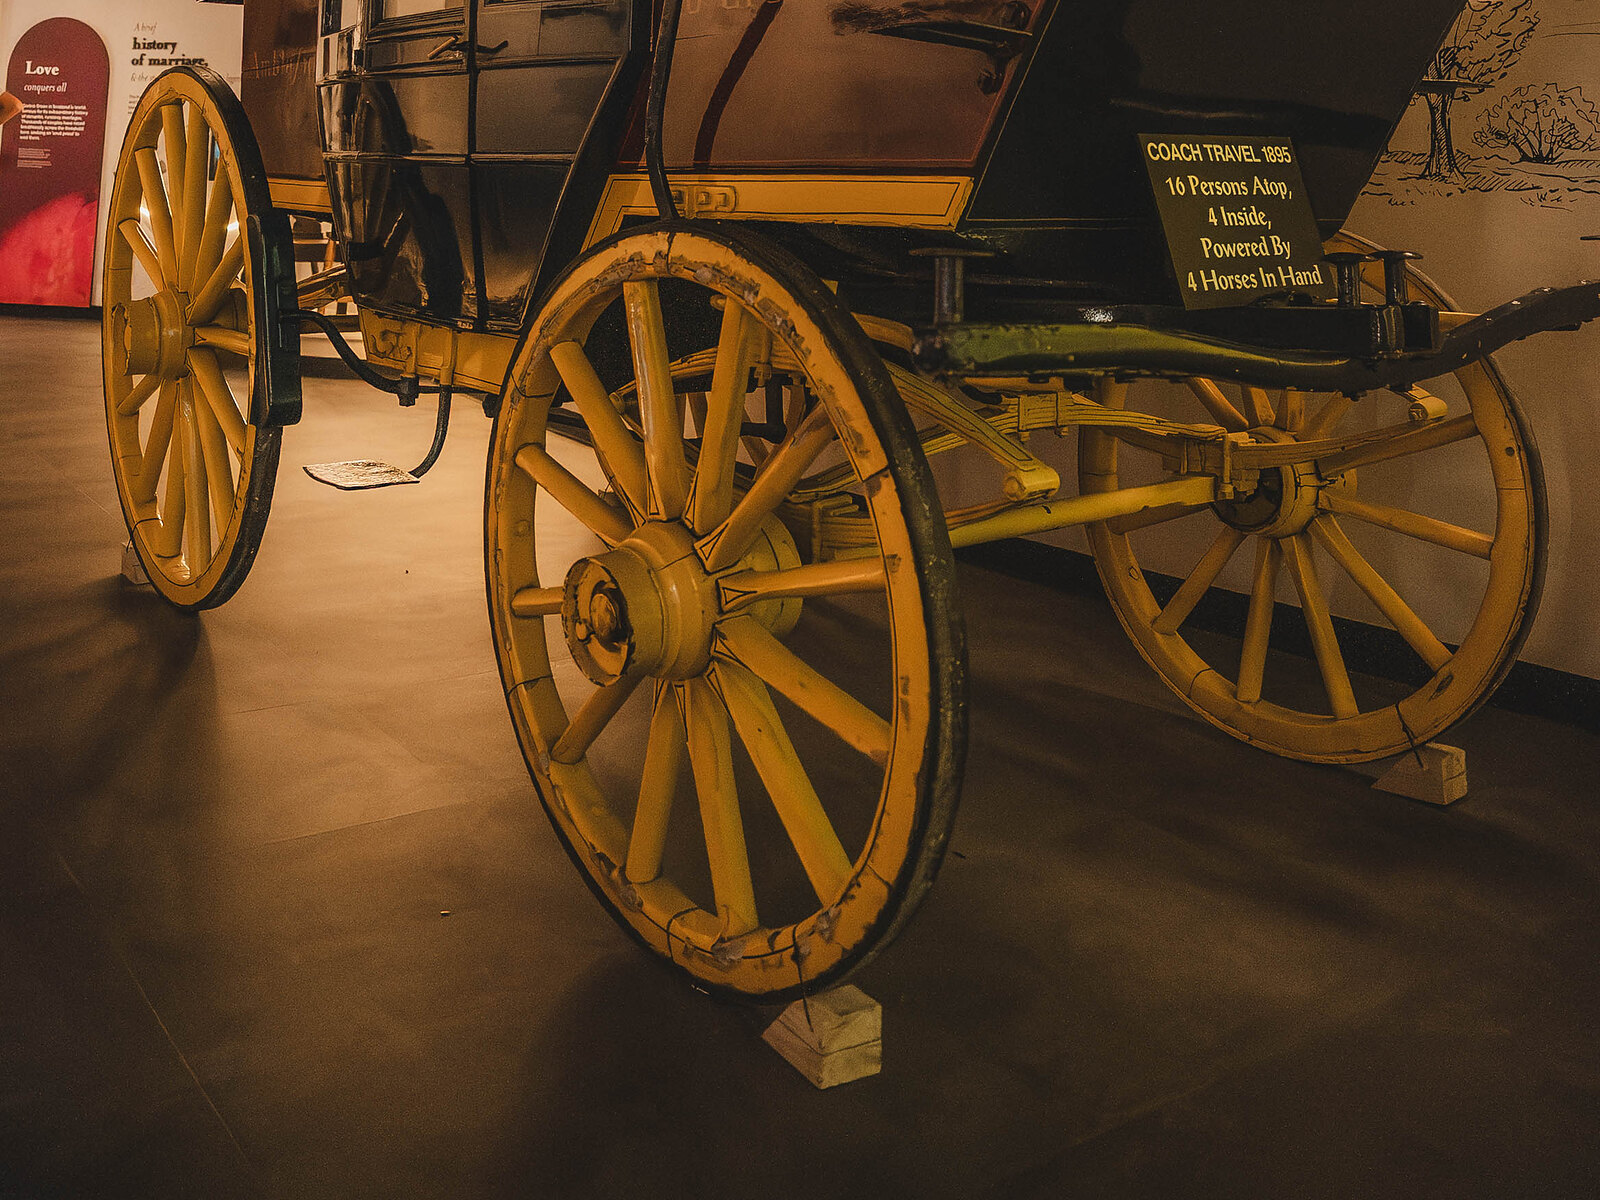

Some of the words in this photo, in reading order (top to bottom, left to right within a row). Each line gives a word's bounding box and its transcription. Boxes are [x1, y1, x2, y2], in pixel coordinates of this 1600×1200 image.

[131, 37, 178, 55] history
[25, 60, 60, 76] Love
[131, 54, 147, 67] of
[23, 83, 56, 95] conquers
[56, 82, 68, 93] all
[1146, 142, 1203, 162] COACH
[1203, 144, 1261, 163] TRAVEL
[1261, 146, 1292, 164] 1895
[1165, 176, 1186, 196] 16
[1187, 175, 1248, 196] Persons
[1252, 175, 1292, 200] Atop,
[1208, 206, 1218, 226] 4
[1220, 205, 1272, 230] Inside,
[1200, 235, 1270, 259] Powered
[1269, 235, 1292, 260] By
[1187, 271, 1197, 292] 4
[1200, 269, 1258, 292] Horses
[1259, 267, 1278, 288] In
[1278, 264, 1324, 287] Hand
